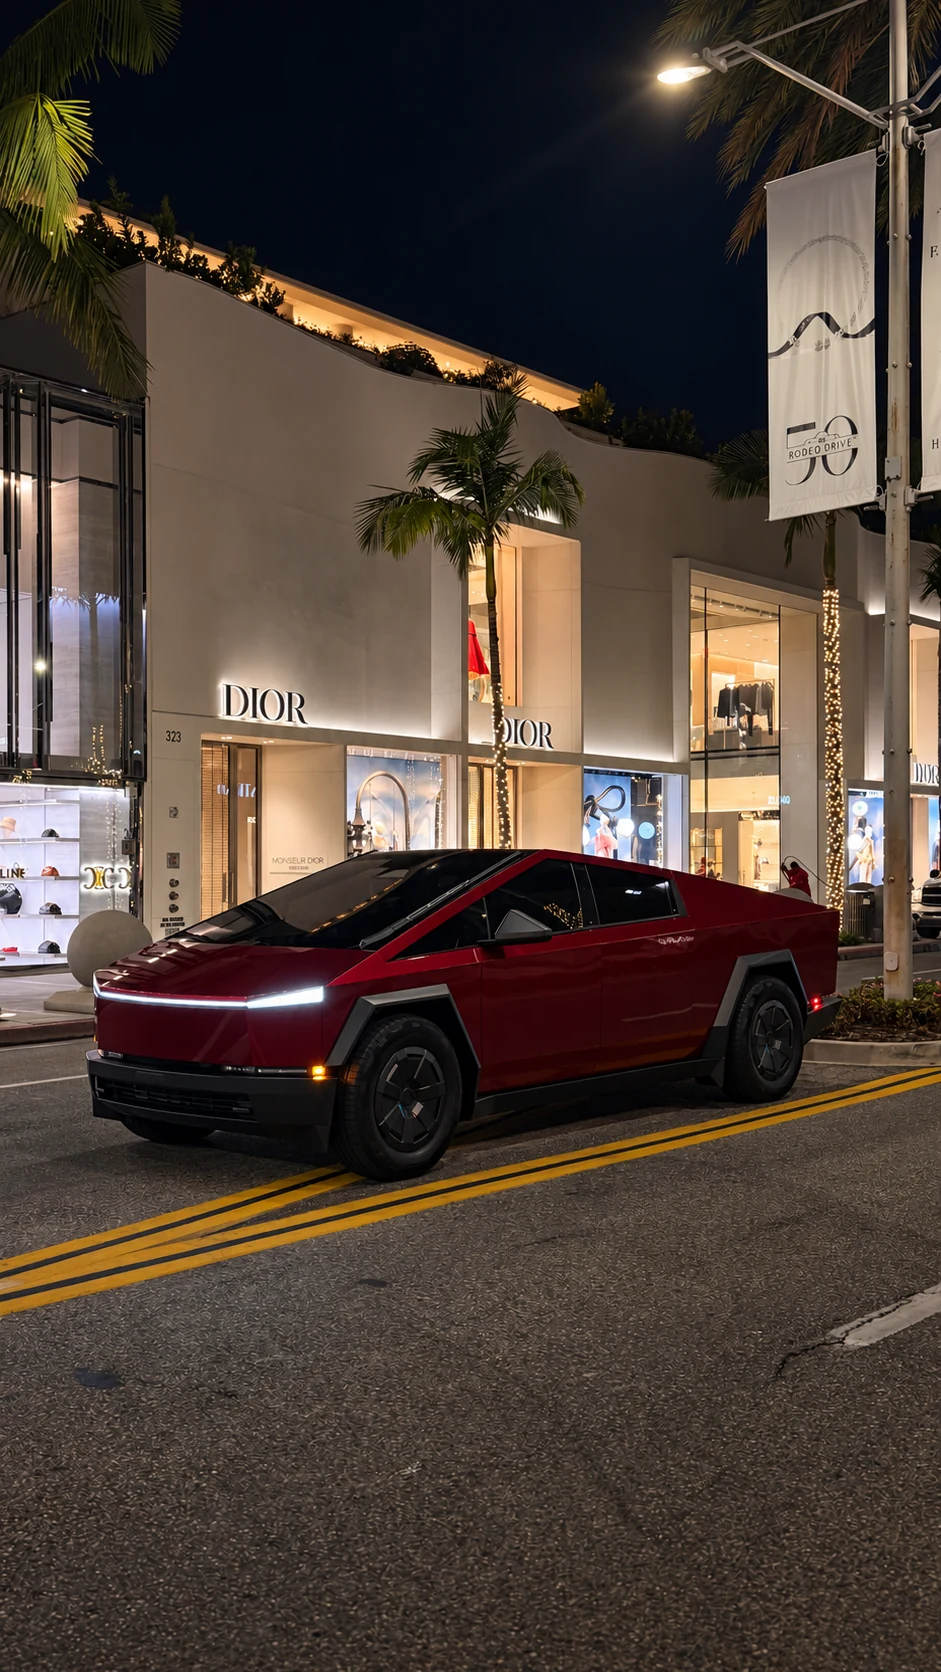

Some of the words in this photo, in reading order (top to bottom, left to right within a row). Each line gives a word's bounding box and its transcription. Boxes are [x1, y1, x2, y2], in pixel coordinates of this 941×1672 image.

[785, 415, 858, 486] 50
[788, 445, 821, 460] RODEO
[824, 437, 852, 453] DRIVE
[221, 683, 308, 725] DIOR
[165, 730, 182, 743] 323
